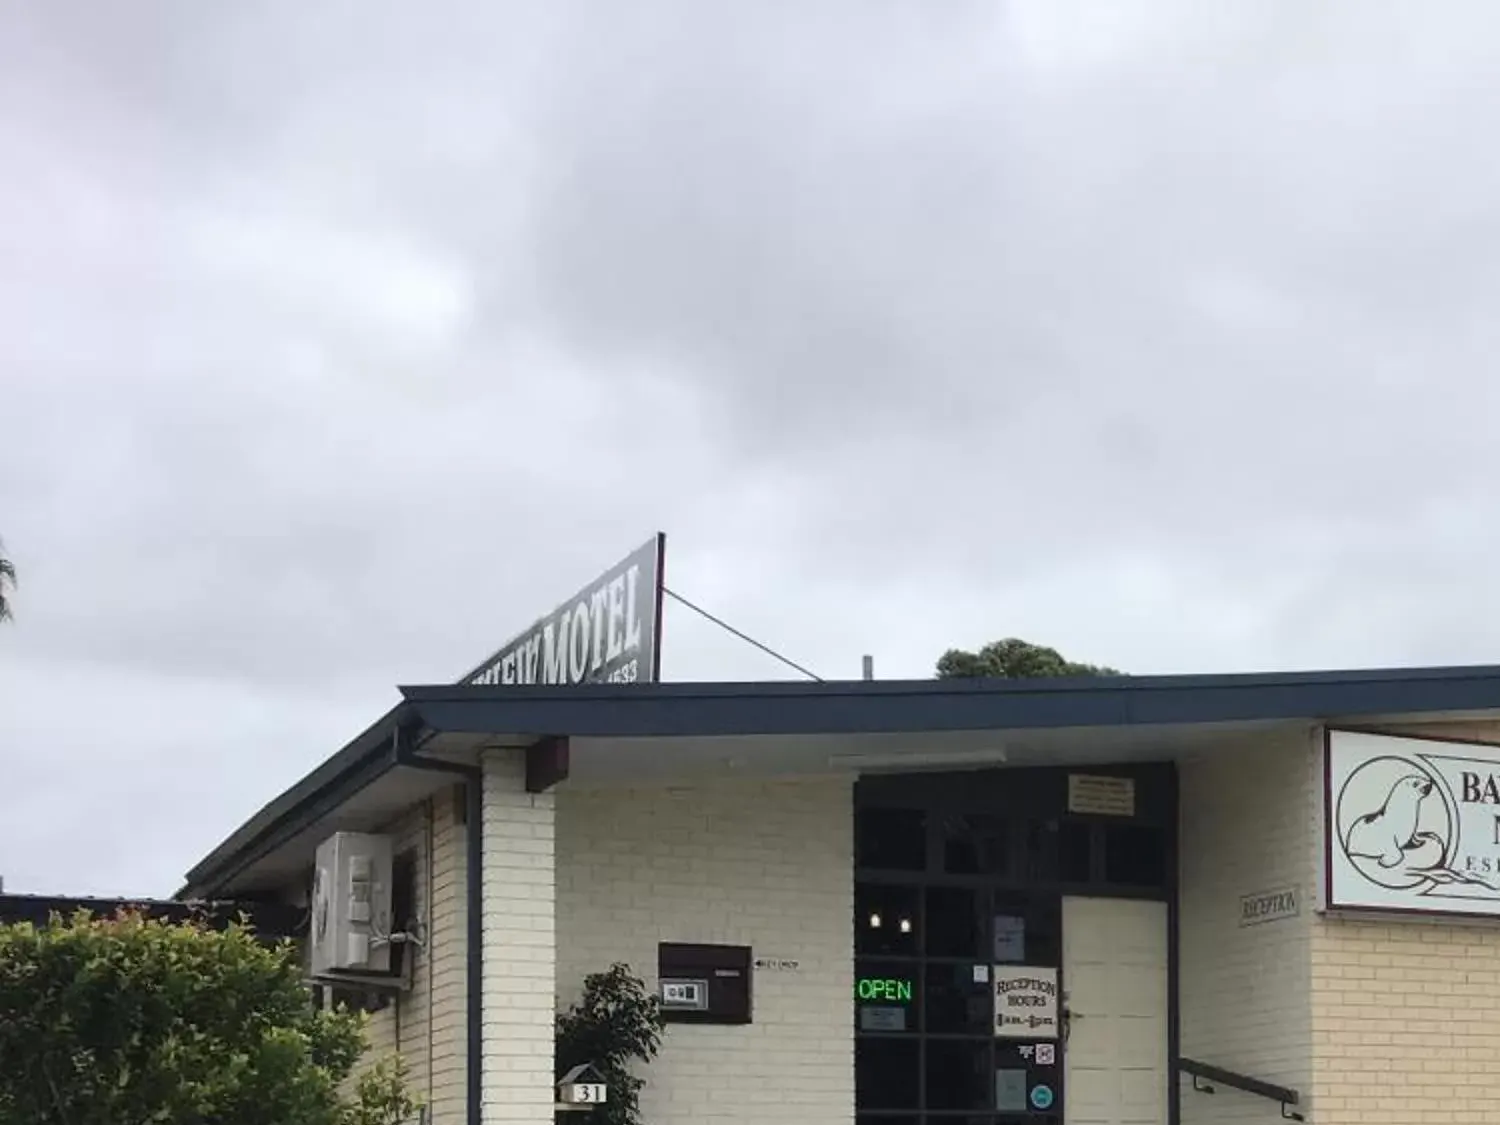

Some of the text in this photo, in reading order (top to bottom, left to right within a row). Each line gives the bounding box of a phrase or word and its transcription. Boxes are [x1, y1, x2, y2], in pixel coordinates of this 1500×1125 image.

[543, 564, 641, 684] MOTEL
[859, 979, 911, 1000] OPEN
[997, 978, 1055, 997] RECEPTION
[1008, 995, 1046, 1007] HOURS
[582, 1085, 600, 1101] 31
